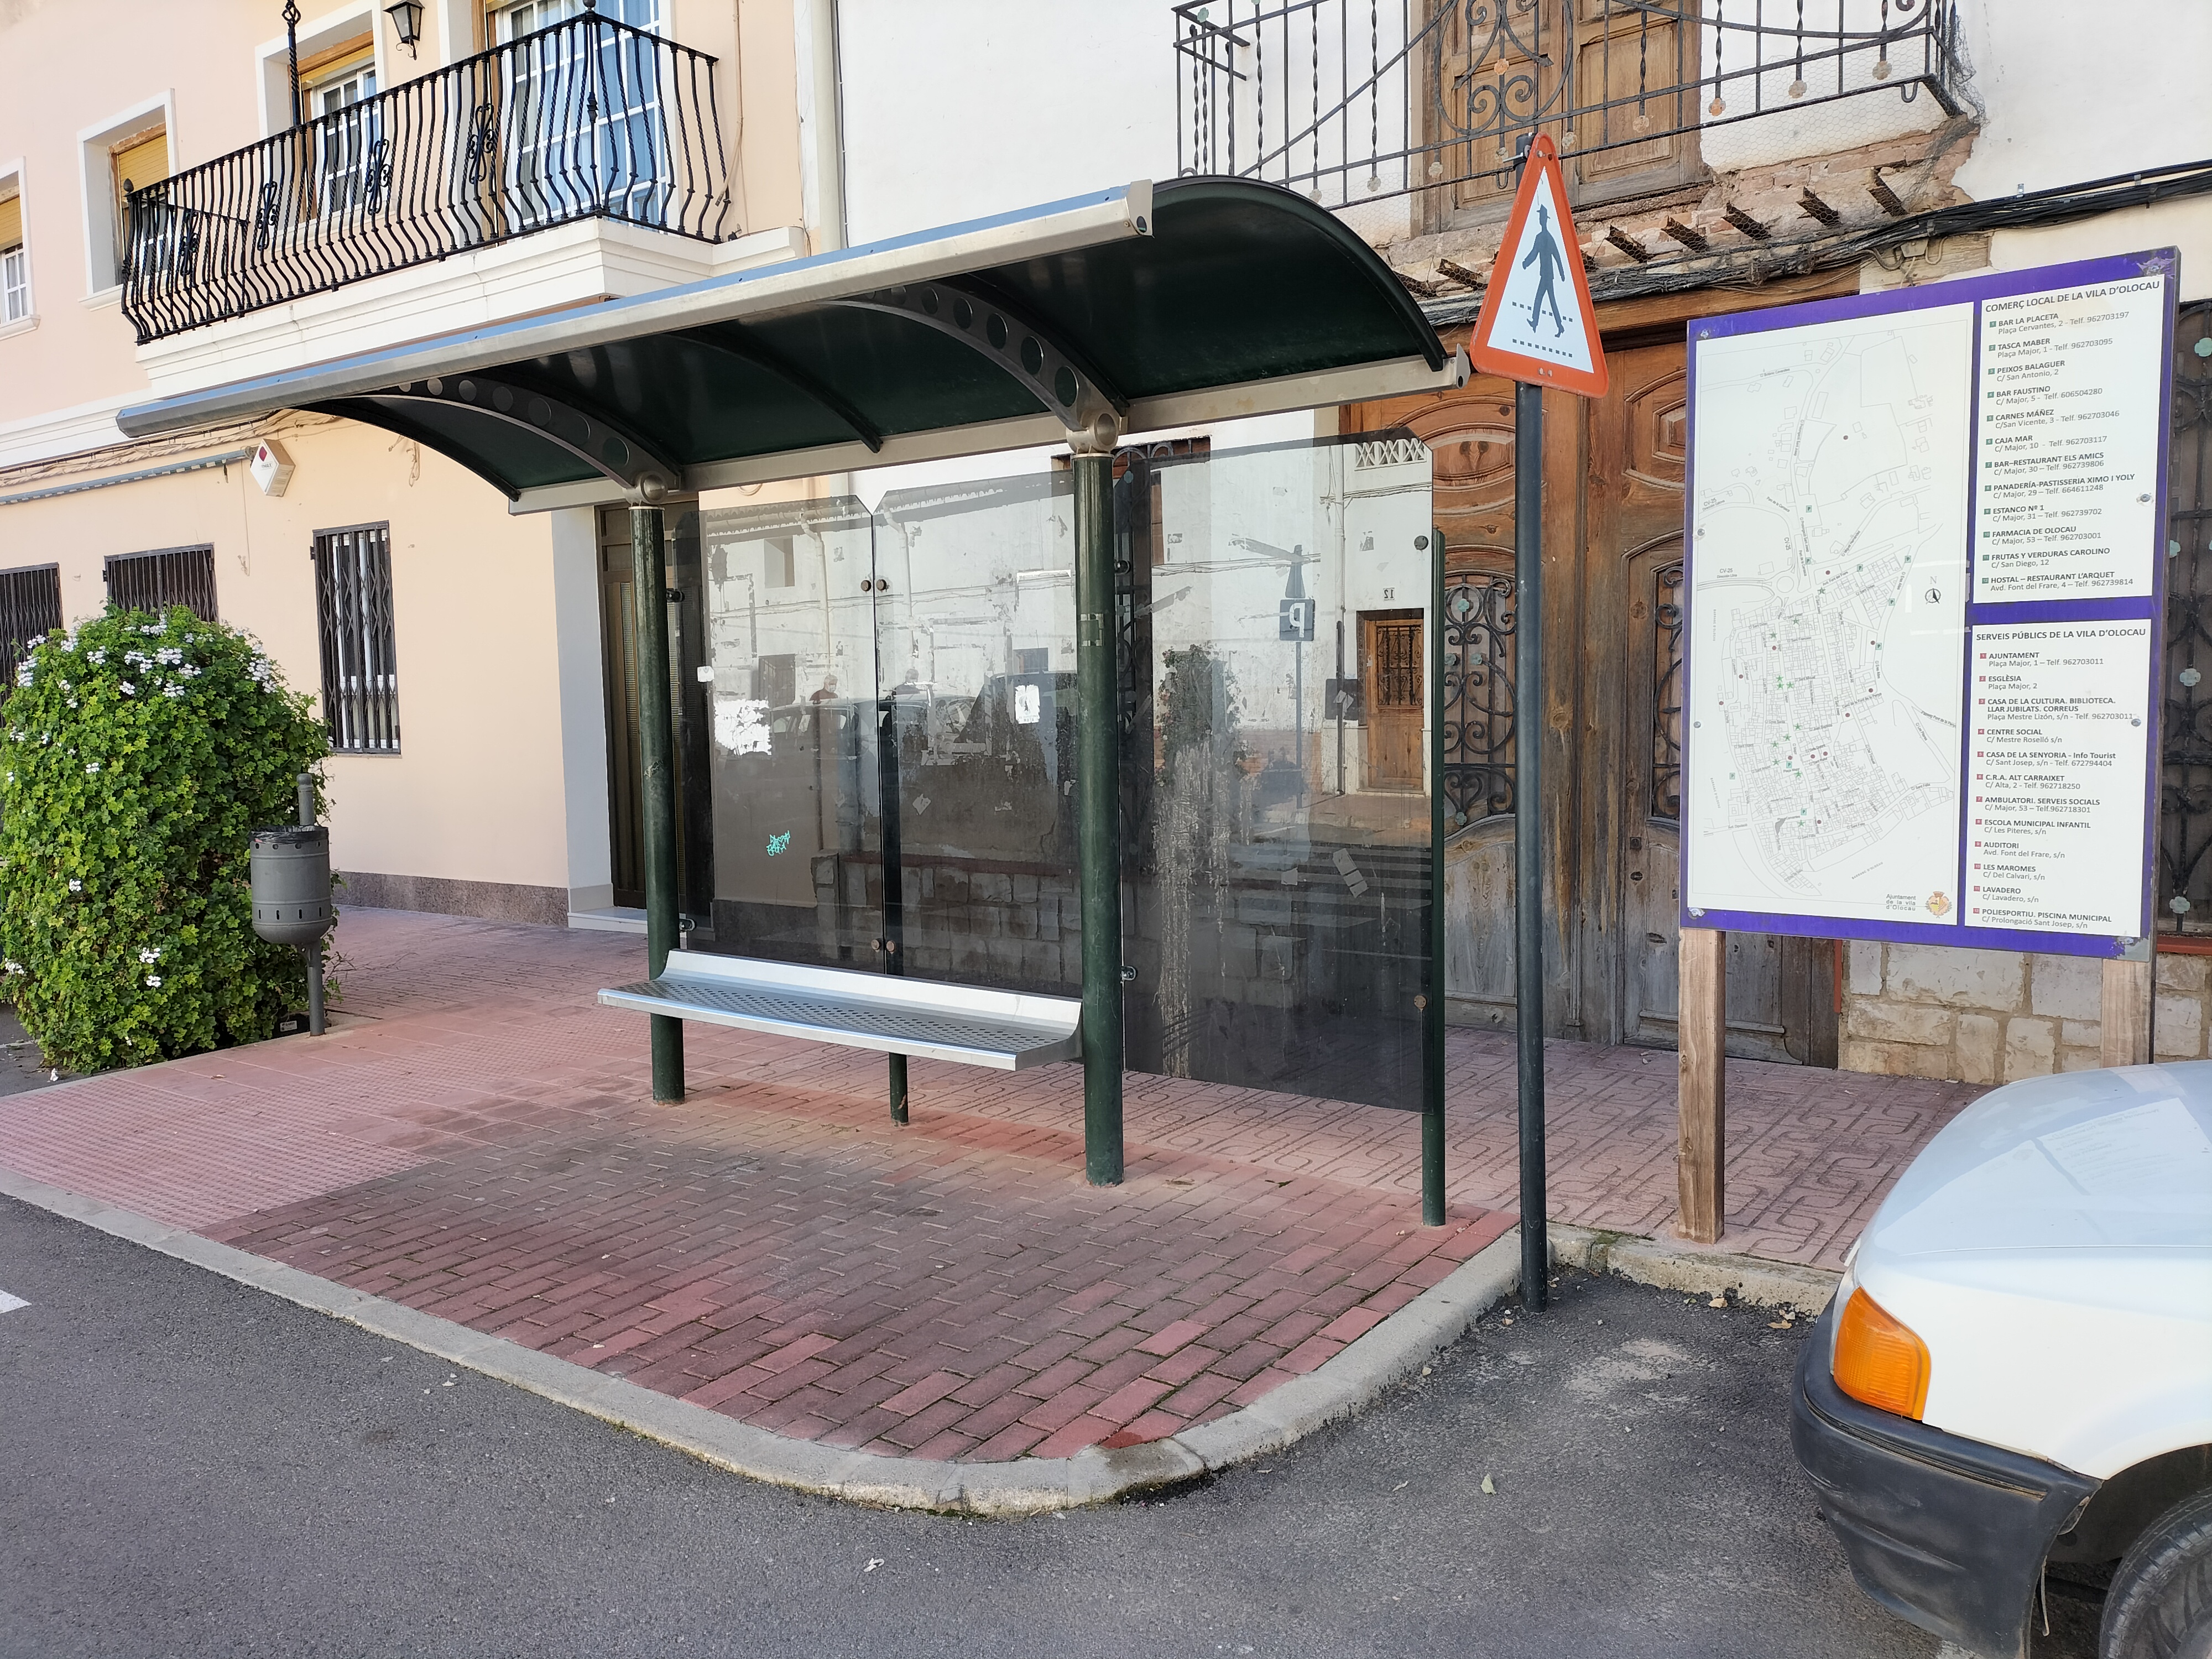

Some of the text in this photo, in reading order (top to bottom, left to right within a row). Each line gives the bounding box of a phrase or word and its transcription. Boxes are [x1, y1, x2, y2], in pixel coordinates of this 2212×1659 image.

[1985, 300, 2024, 312] COMERÇ
[2026, 296, 2055, 306] LOCAL
[2057, 294, 2069, 302] DE
[2085, 289, 2106, 298] VILA
[2018, 322, 2056, 332] Cervantes,
[2086, 311, 2129, 322] 962703197
[2026, 313, 2059, 323] PLACETA
[1997, 338, 2050, 350] TASCA MABER
[2070, 338, 2112, 349] 962703095
[1997, 360, 2065, 374] PEIXOS BALAGUER
[2013, 385, 2051, 395] FAUSTINO
[1995, 409, 2054, 421] CARNES MÁÑEZ
[2078, 410, 2119, 420] 962703046
[2065, 435, 2107, 445] 962703117
[2078, 452, 2104, 460] AMICS
[1992, 529, 2031, 537] FARMACIA
[2027, 550, 2068, 558] VERDURAS
[2069, 547, 2110, 556] CAROLINO
[1929, 576, 1938, 585] N
[2027, 573, 2076, 582] RESTAURANT
[2012, 630, 2047, 639] PÚBLICS
[1982, 909, 2036, 917] POLIESPORTIU.
[2069, 914, 2112, 922] MUNICIPAL
